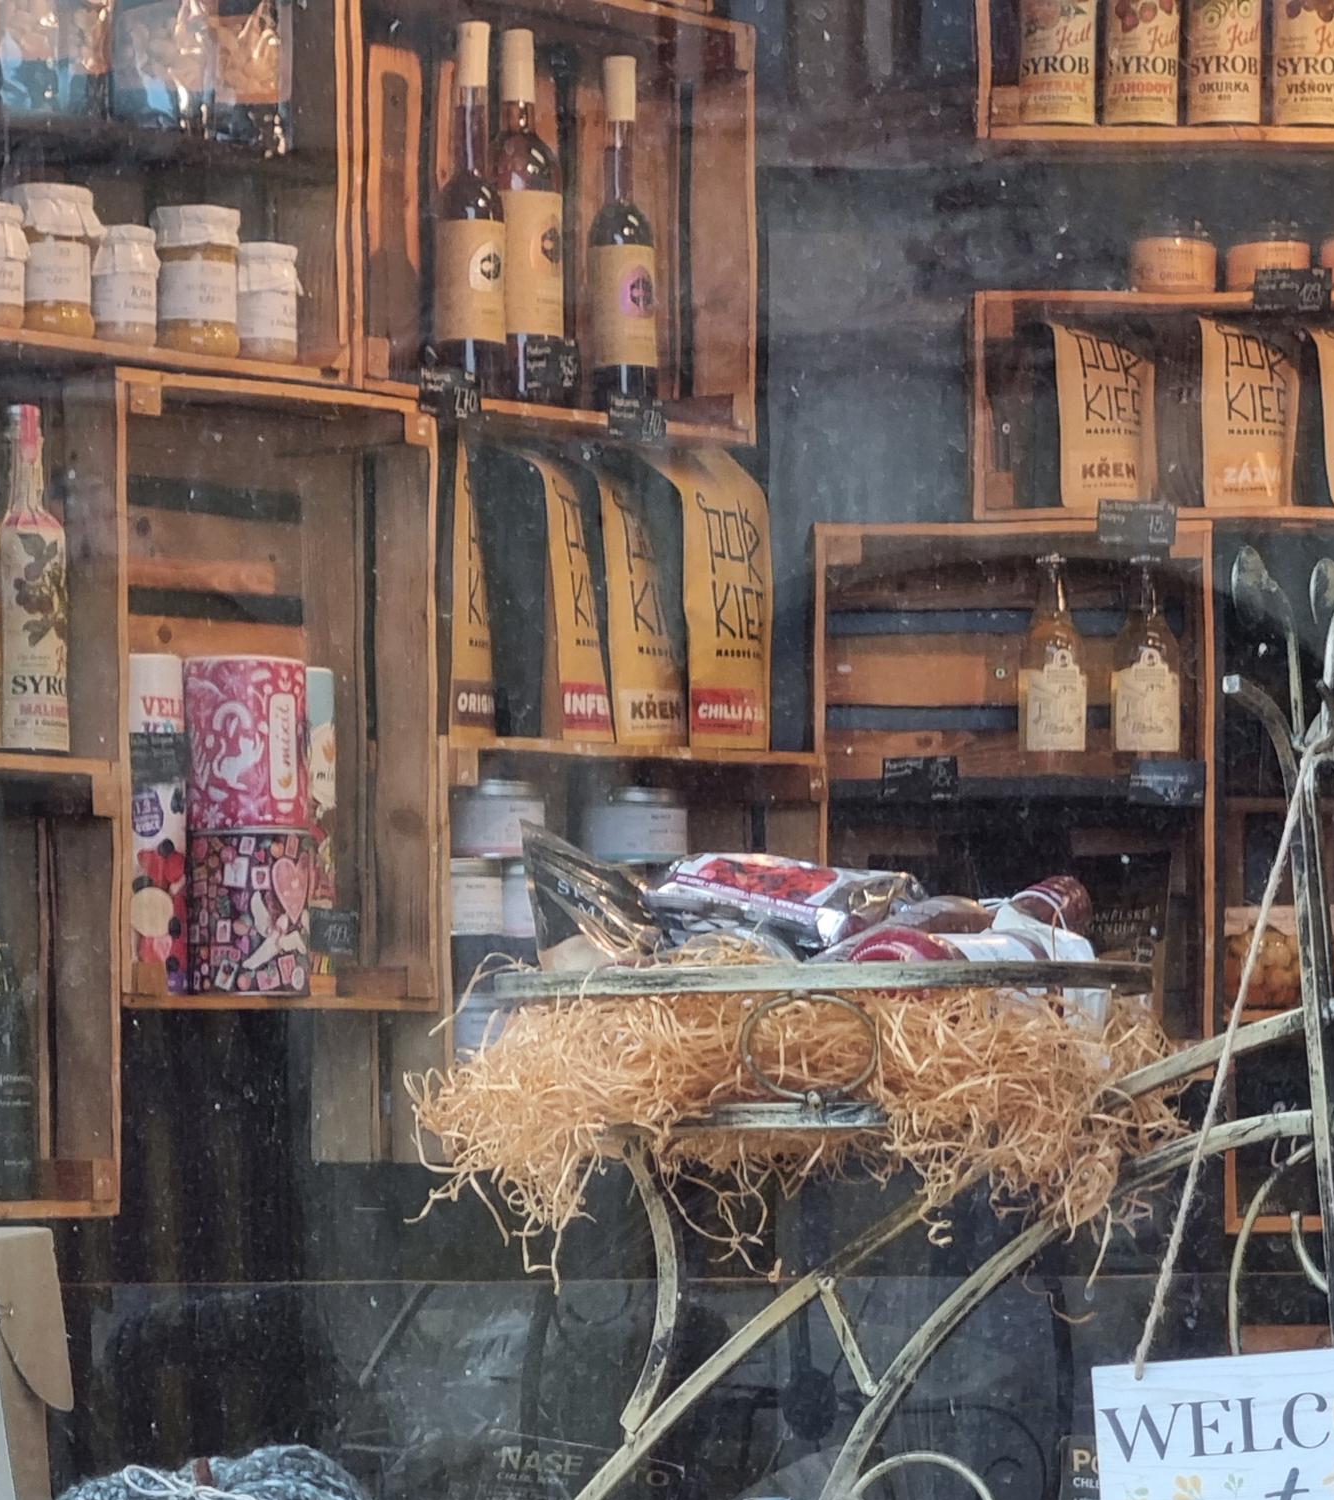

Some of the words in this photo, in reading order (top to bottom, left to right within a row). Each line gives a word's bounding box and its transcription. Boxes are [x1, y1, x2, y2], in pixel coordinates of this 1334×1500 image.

[1021, 54, 1090, 77] SYROB
[1189, 54, 1258, 76] SYROB
[1198, 82, 1251, 94] OKURKA
[630, 693, 681, 720] KŘEN
